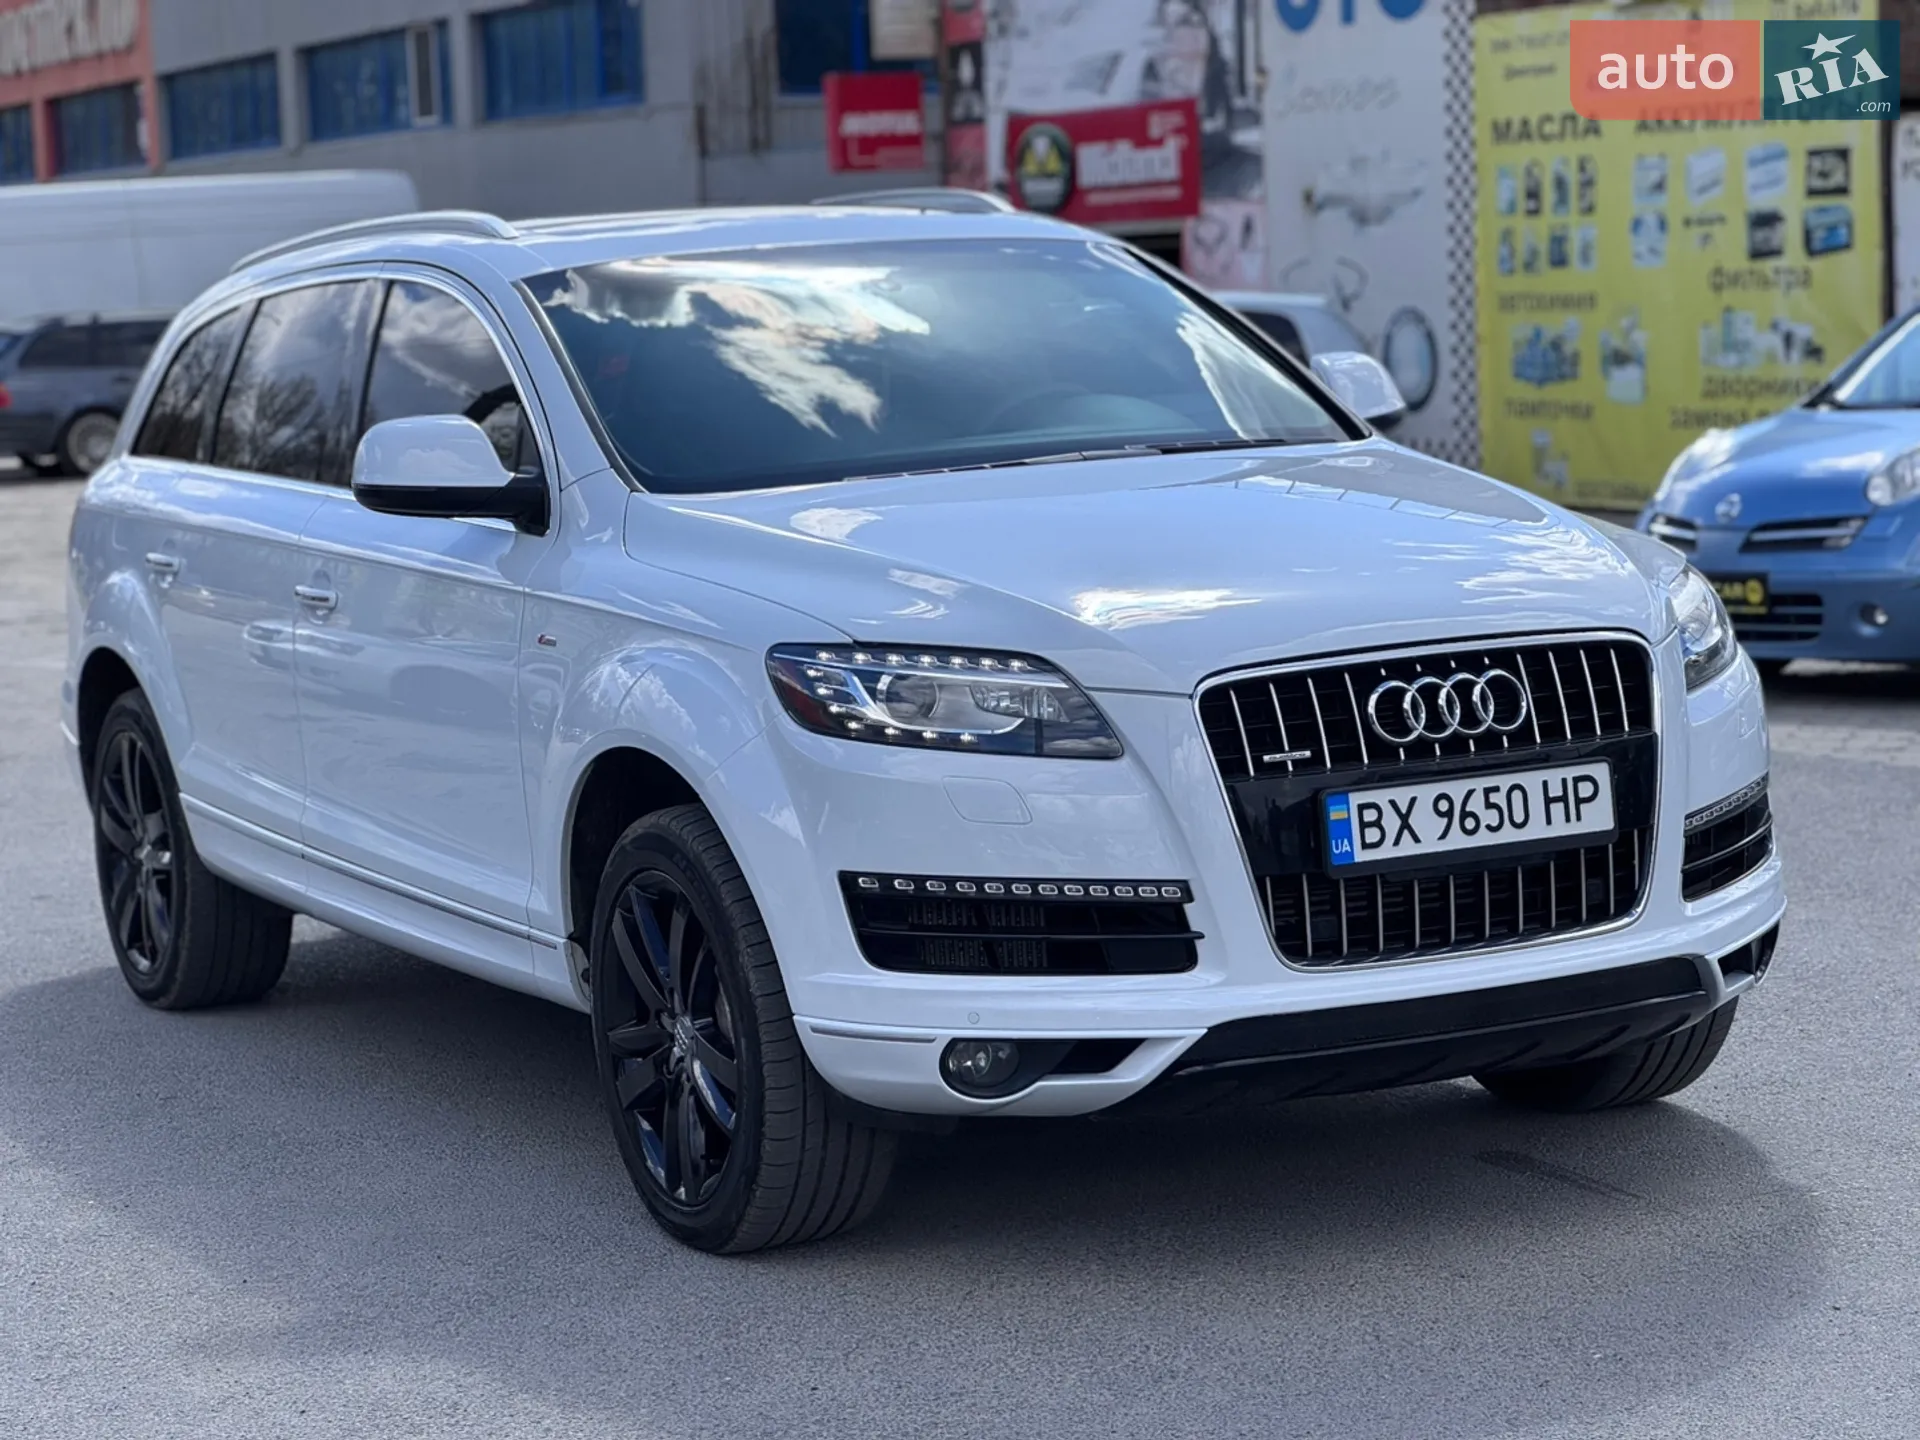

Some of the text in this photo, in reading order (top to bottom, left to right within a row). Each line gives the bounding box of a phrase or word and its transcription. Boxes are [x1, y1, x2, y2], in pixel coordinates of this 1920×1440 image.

[1490, 109, 1603, 146] МАСЛА
[1357, 774, 1600, 850] BX 9650 HP
[1331, 838, 1351, 855] UA
